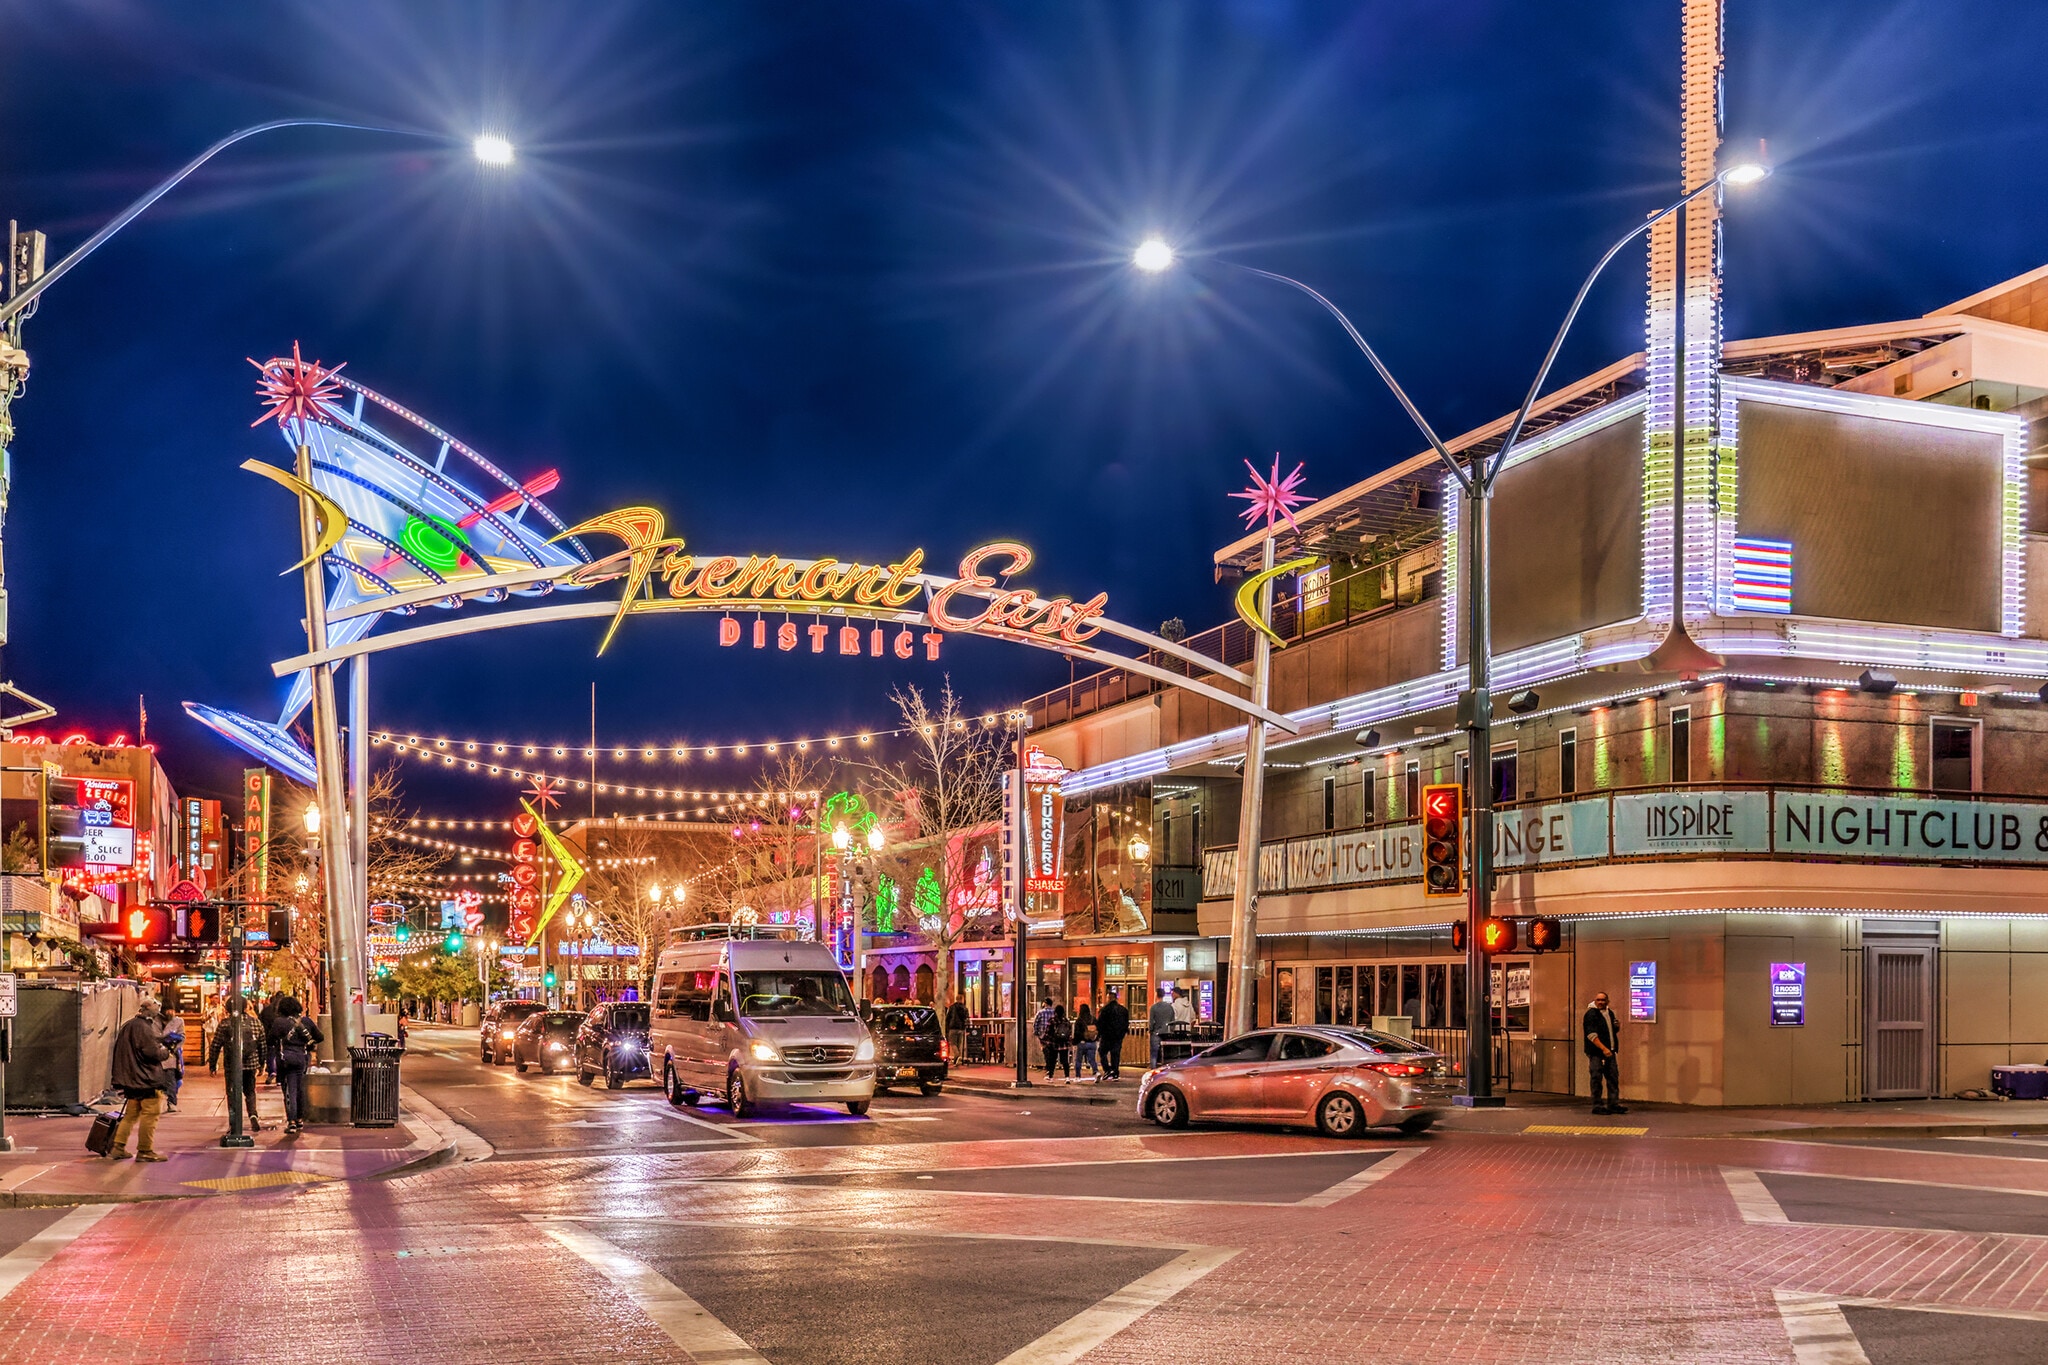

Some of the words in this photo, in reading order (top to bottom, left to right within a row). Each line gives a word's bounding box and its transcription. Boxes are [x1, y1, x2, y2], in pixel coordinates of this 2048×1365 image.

[542, 506, 924, 657] Fremont
[929, 542, 1108, 642] East
[719, 616, 943, 661] DISTRICT
[1041, 794, 1053, 875] BURGERS
[1647, 799, 1734, 838] INSPIRE
[1786, 803, 2021, 851] NIGHTCLUB
[98, 845, 122, 854] SLICE
[1290, 836, 1411, 886] NIGHTCLUB
[1648, 839, 1690, 848] NIGHTCLUB
[1702, 839, 1732, 847] LOUNGE
[516, 817, 537, 935] VEGAS
